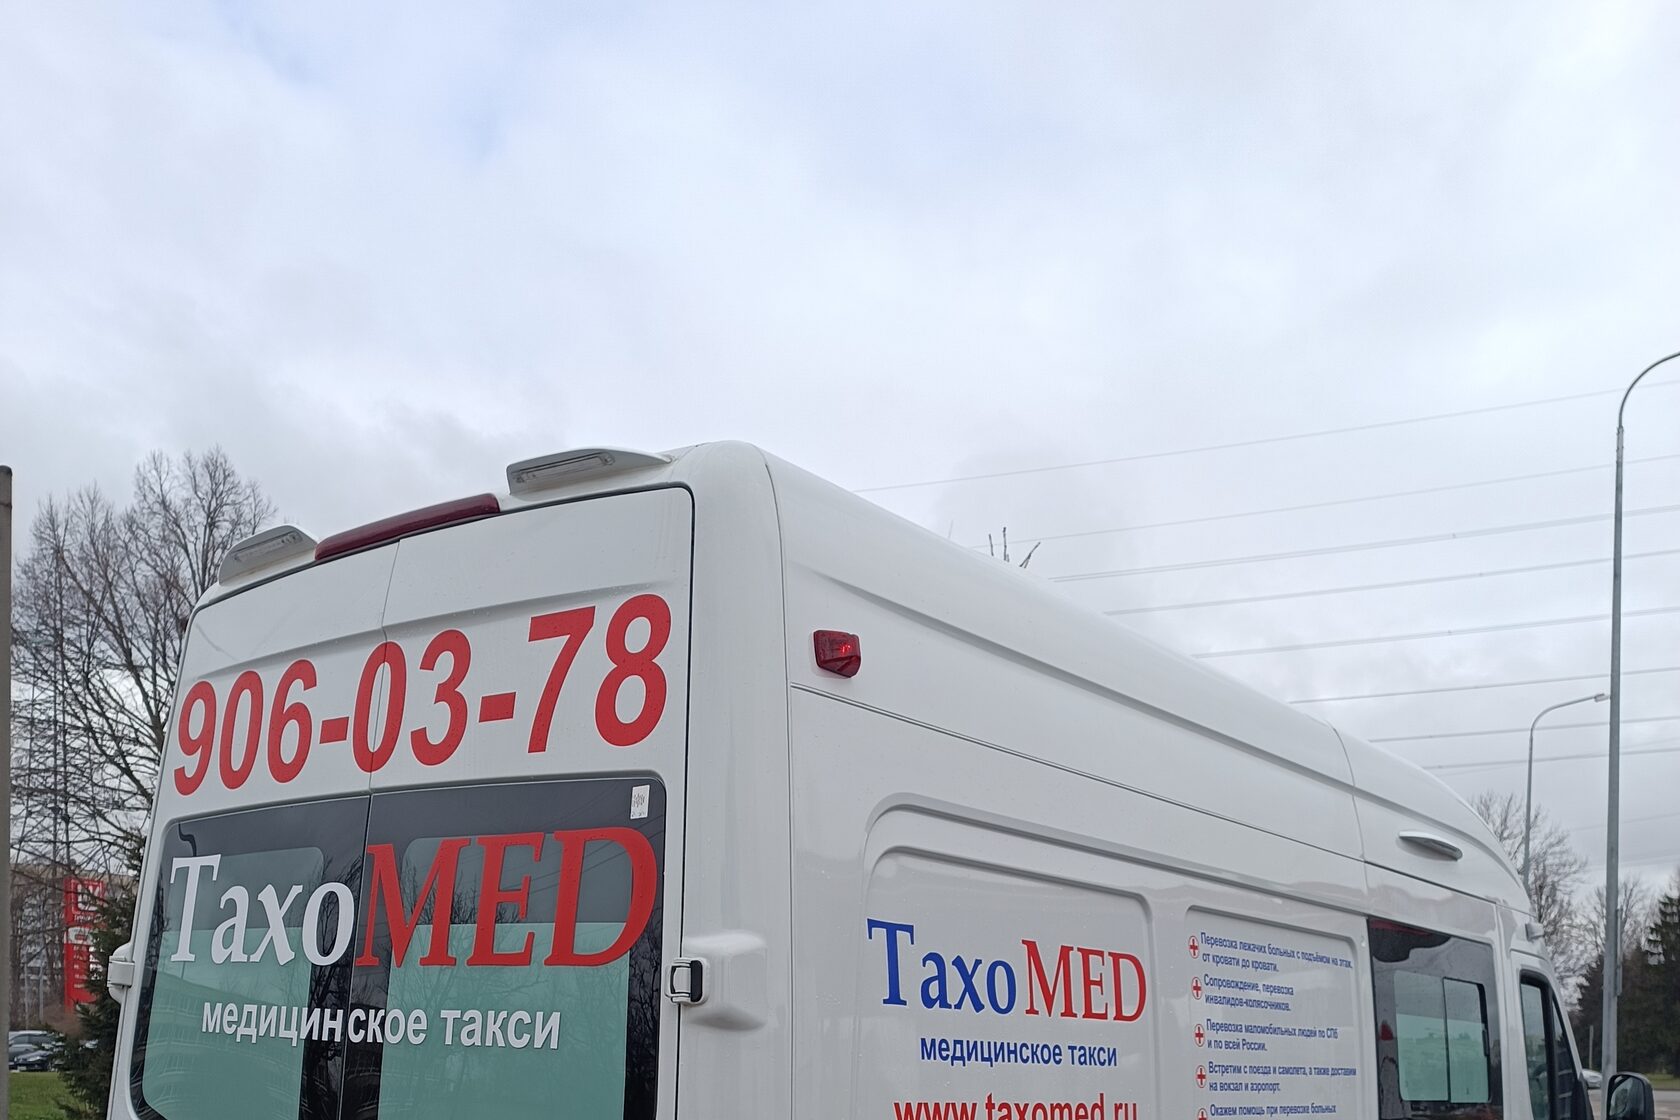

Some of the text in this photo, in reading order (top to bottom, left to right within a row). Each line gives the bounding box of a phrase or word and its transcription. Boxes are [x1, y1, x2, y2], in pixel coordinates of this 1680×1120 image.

[173, 594, 672, 796] 906-03-78
[1200, 932, 1238, 950] Перевозка
[1238, 941, 1267, 954] лежачих
[1267, 943, 1296, 959] больных
[1301, 951, 1331, 965] подъёмом
[1331, 957, 1338, 966] на
[1202, 953, 1279, 972] от кровати до кровати.
[1203, 973, 1294, 996] Сопровождение, перевозка
[201, 1001, 561, 1050] медицинское такси
[1206, 1018, 1243, 1035] Перевозка
[1244, 1023, 1297, 1037] маломобильных
[1297, 1026, 1318, 1039] людей
[1318, 1029, 1325, 1038] по
[920, 1037, 1117, 1067] медицинское такси
[1207, 1038, 1267, 1051] и по всей России.
[1208, 1061, 1242, 1076] Встретим
[1243, 1065, 1248, 1074] с
[1248, 1065, 1271, 1076] поезда
[1272, 1065, 1277, 1074] и
[1308, 1067, 1313, 1076] а
[1313, 1066, 1330, 1076] также
[1330, 1066, 1357, 1077] доставим
[1209, 1082, 1281, 1094] на вокзал и аэропорт.
[1210, 1102, 1337, 1117] Окажем помощь при перевозке больных
